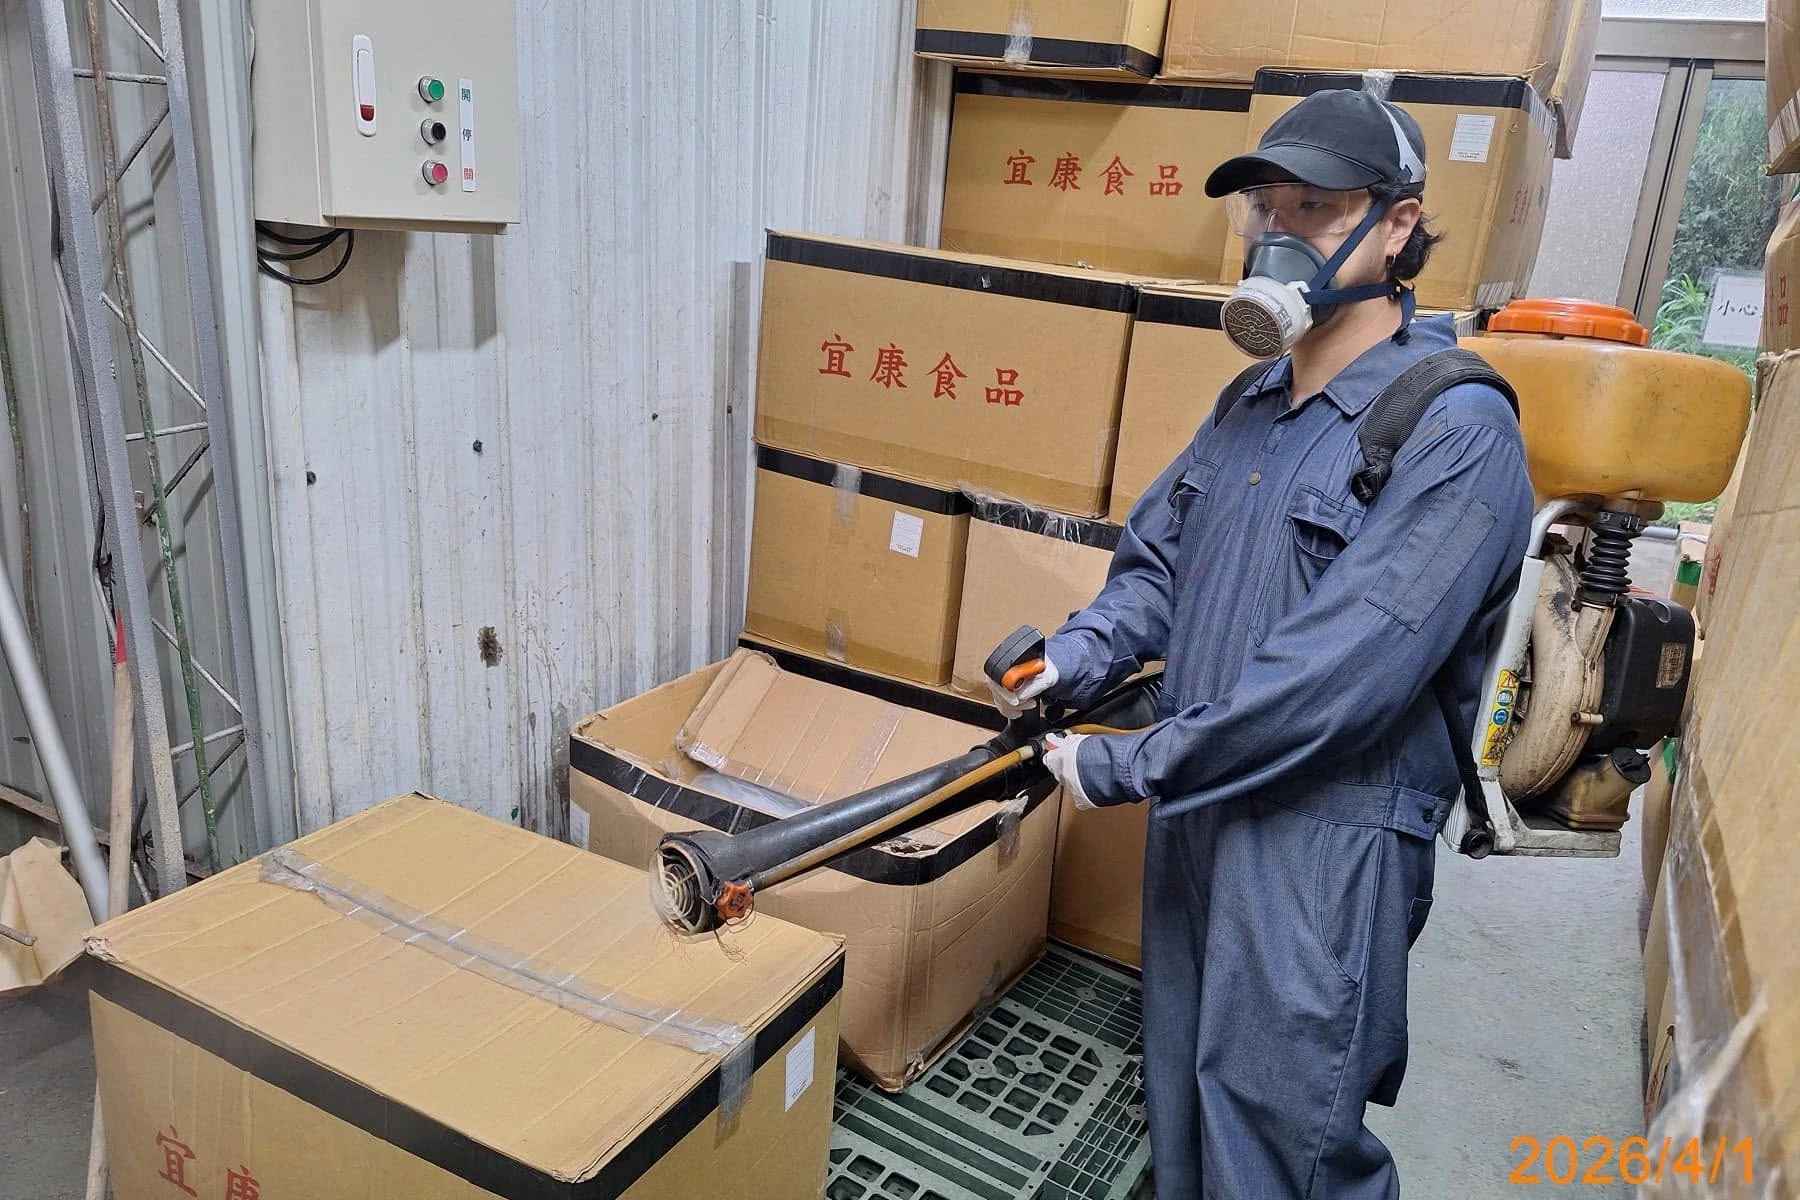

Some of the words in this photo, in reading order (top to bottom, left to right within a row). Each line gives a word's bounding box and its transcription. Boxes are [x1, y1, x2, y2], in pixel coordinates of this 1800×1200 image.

[461, 87, 471, 102] 開
[1003, 149, 1183, 197] 宜康食品
[1717, 300, 1758, 316] 小心
[818, 333, 1024, 406] 宜康食品
